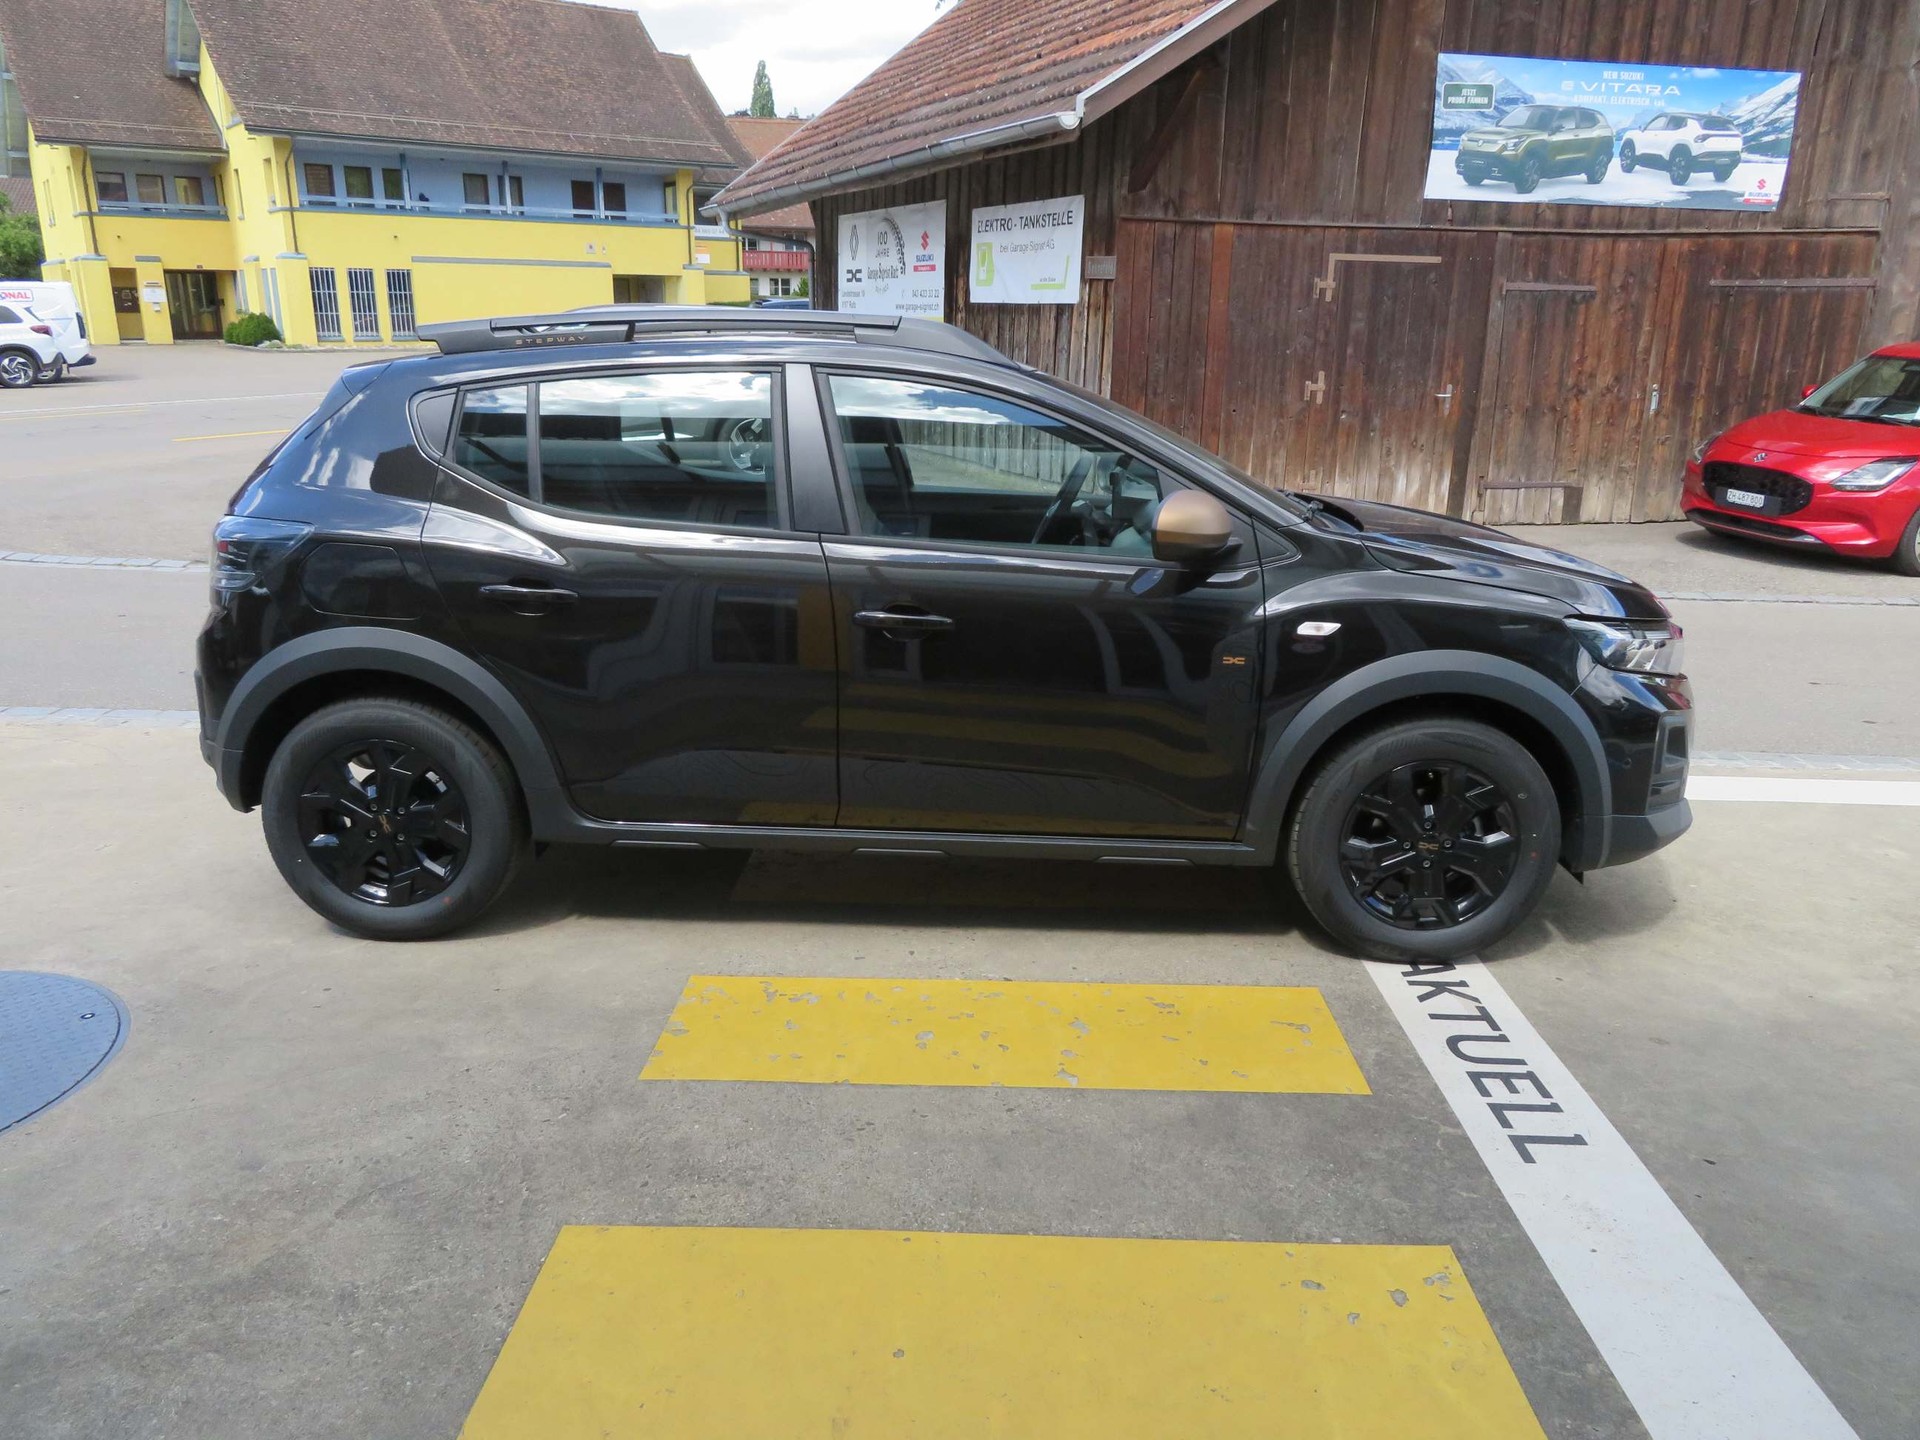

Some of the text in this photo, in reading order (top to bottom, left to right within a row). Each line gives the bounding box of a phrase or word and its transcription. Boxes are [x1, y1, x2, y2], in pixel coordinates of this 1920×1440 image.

[1620, 71, 1645, 81] SUZUKI
[877, 230, 888, 246] 100
[515, 336, 586, 345] STEPWAY
[1401, 961, 1589, 1164] AKTUELL
